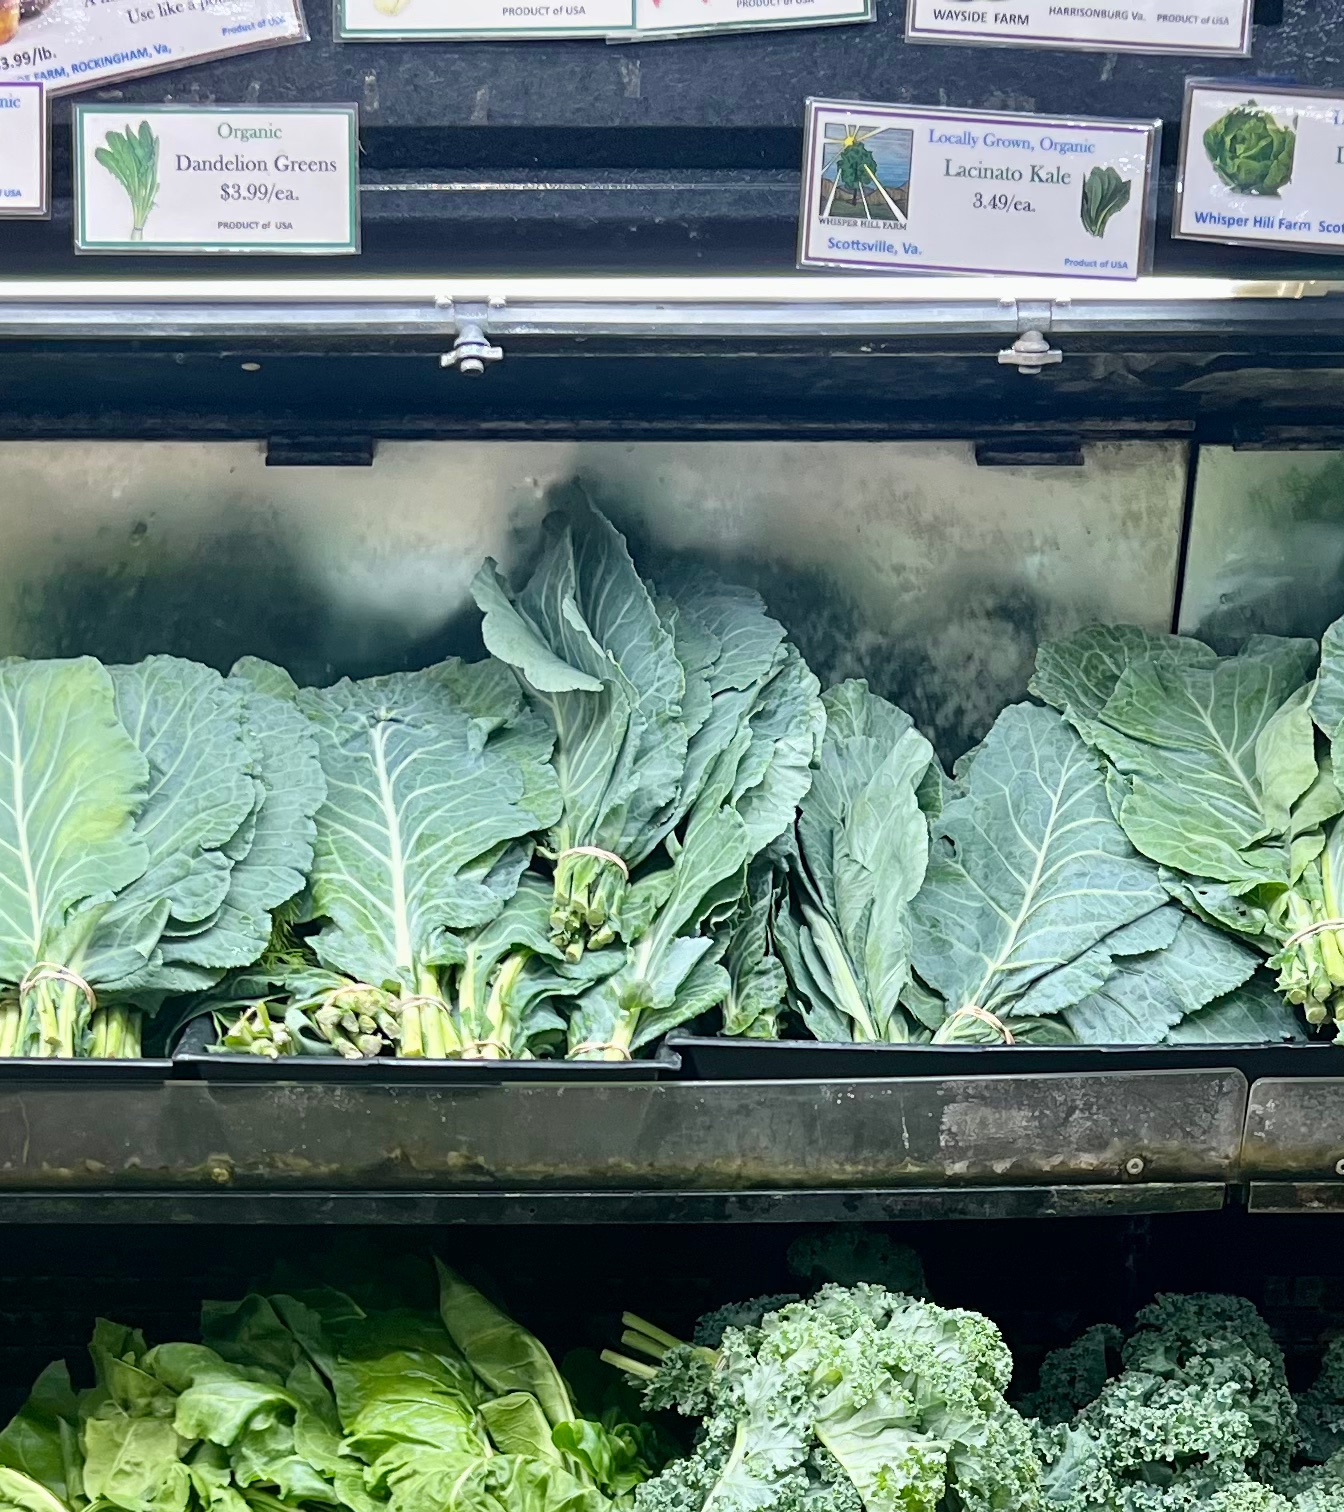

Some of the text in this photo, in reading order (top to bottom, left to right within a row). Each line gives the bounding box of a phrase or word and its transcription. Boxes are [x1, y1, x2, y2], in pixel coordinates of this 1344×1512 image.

[127, 8, 155, 24] Use
[157, 0, 185, 17] like
[502, 6, 586, 16] PRODUCT of USA
[932, 9, 1029, 26] WAYSIDE FARM
[1048, 6, 1128, 20] HARRISONBURG
[1156, 14, 1199, 24] PRODUCT
[1201, 14, 1210, 24] of
[1212, 16, 1230, 26] USA
[222, 23, 255, 37] Product
[71, 48, 153, 73] ROCKINGHAM,
[217, 122, 282, 142] Organic
[928, 128, 1095, 155] Locally Grown, Organic
[176, 154, 337, 172] Dandelion Greens
[944, 159, 1072, 184] Lacinato Kale
[4, 189, 22, 198] USA
[220, 183, 299, 203] $3.99/ea.
[972, 192, 1036, 213] 3.49/ea.
[217, 221, 293, 230] PRODUCT of USA
[818, 217, 907, 231] WHISPER HILL FARM
[1195, 211, 1249, 229] Whisper
[1278, 218, 1311, 231] Farm
[828, 237, 923, 256] Scottsville, Va.
[1064, 257, 1128, 270] Product of USA
